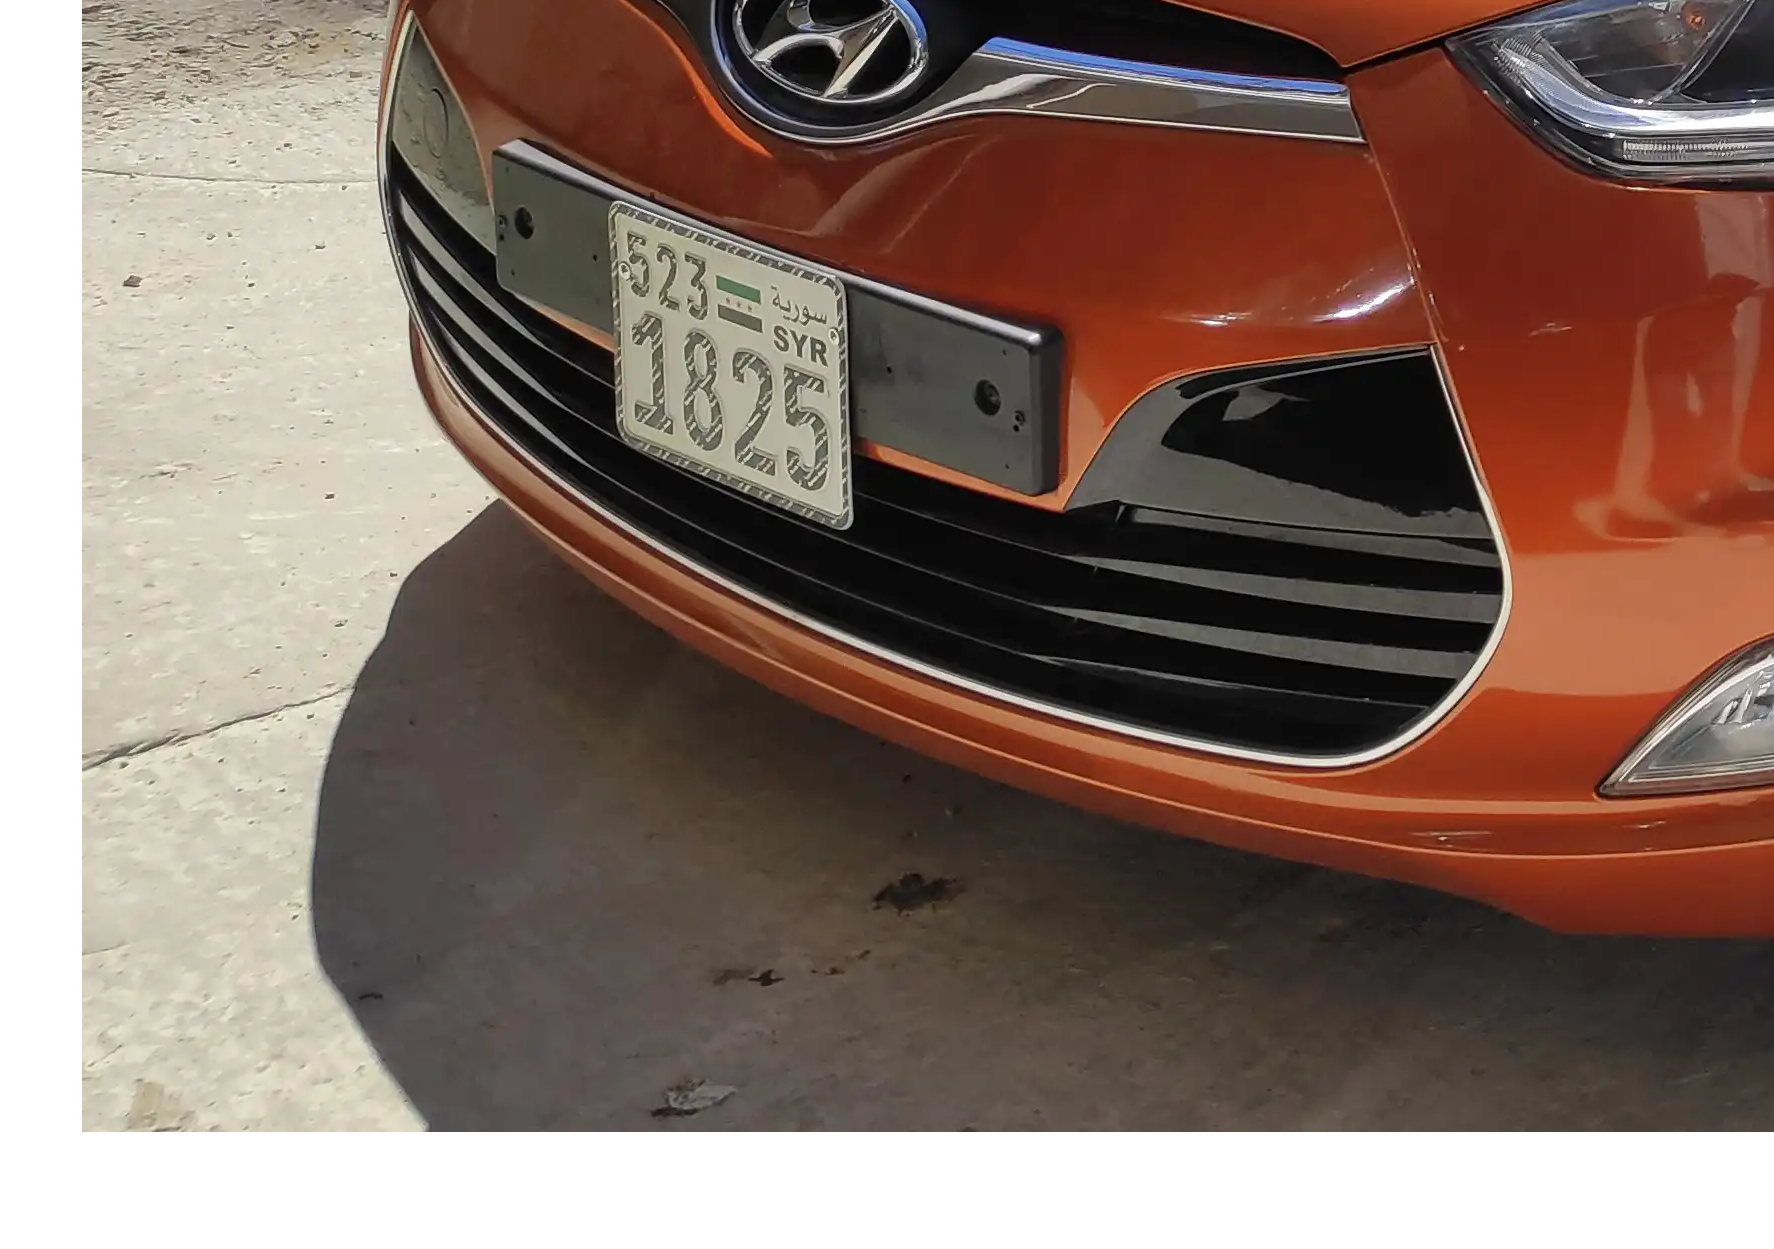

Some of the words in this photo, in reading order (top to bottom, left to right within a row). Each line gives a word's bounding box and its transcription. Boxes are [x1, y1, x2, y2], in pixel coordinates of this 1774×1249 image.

[627, 231, 709, 320] 523
[770, 285, 828, 327] سورية
[773, 325, 829, 367] SYR
[632, 311, 830, 492] 1825
